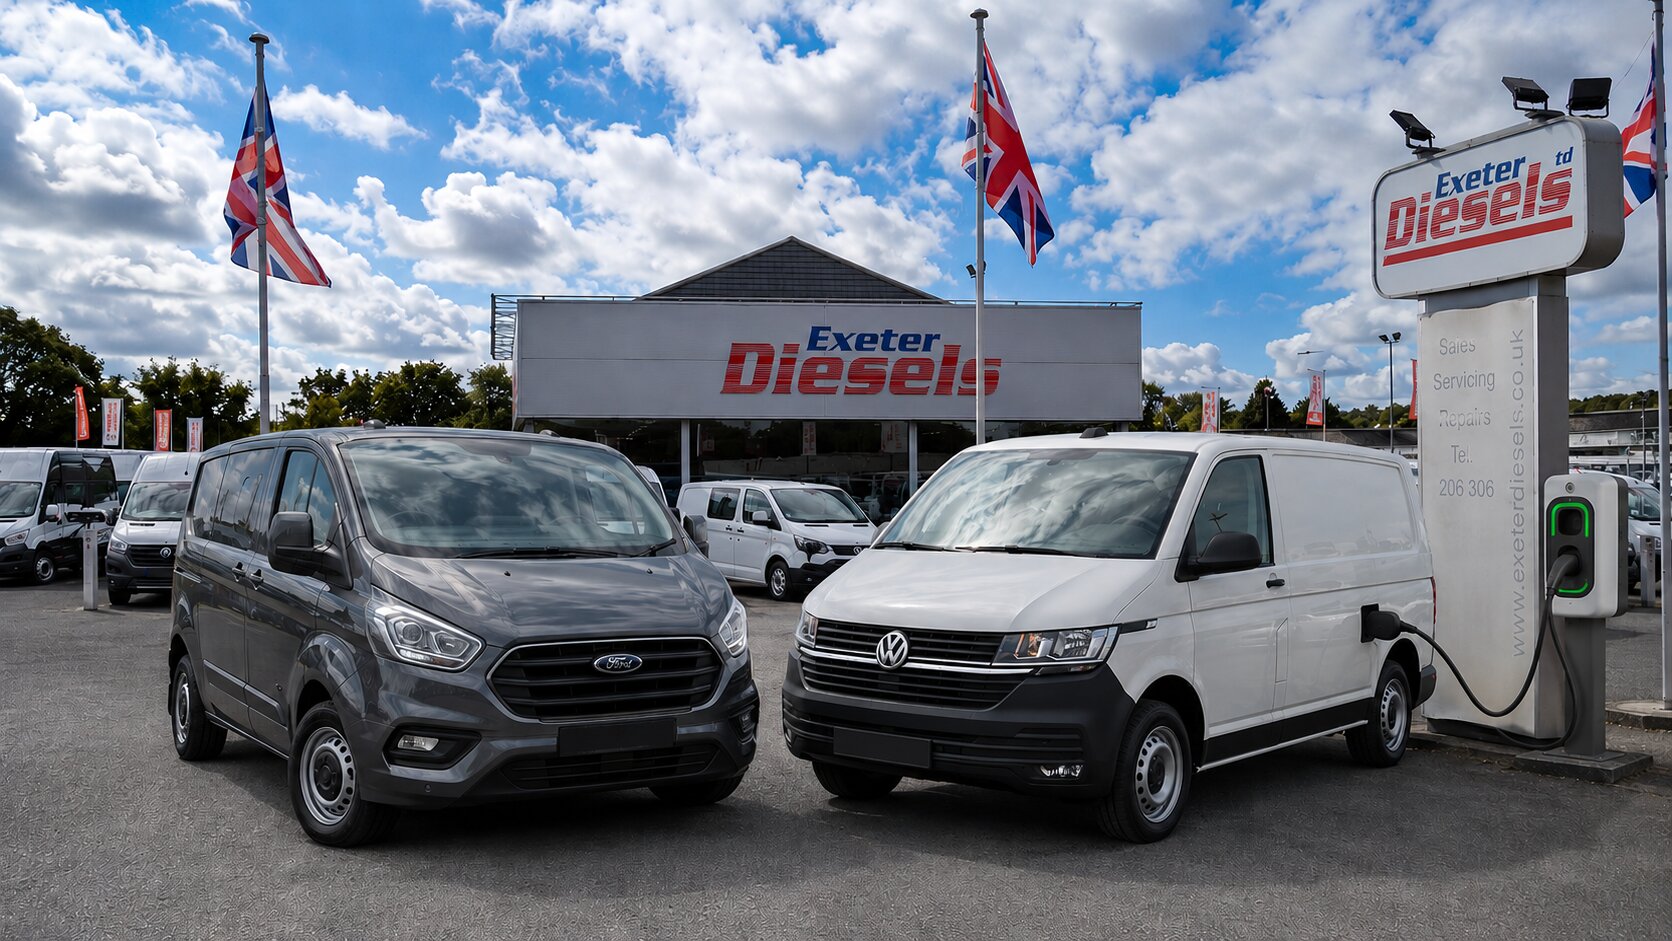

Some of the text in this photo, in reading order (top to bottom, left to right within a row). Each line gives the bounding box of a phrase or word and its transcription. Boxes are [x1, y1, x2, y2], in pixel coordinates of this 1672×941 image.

[1555, 146, 1573, 166] td
[1435, 156, 1526, 199] Exeter
[1385, 162, 1573, 250] Diesels
[806, 326, 941, 352] Exeter
[720, 343, 1002, 396] Diesels
[1433, 370, 1495, 391] Servicing
[1439, 408, 1491, 430] Repairs
[1439, 479, 1495, 498] 206 306
[1509, 329, 1525, 657] www.exeterdiesels.co.uk
[606, 656, 633, 669] Ford
